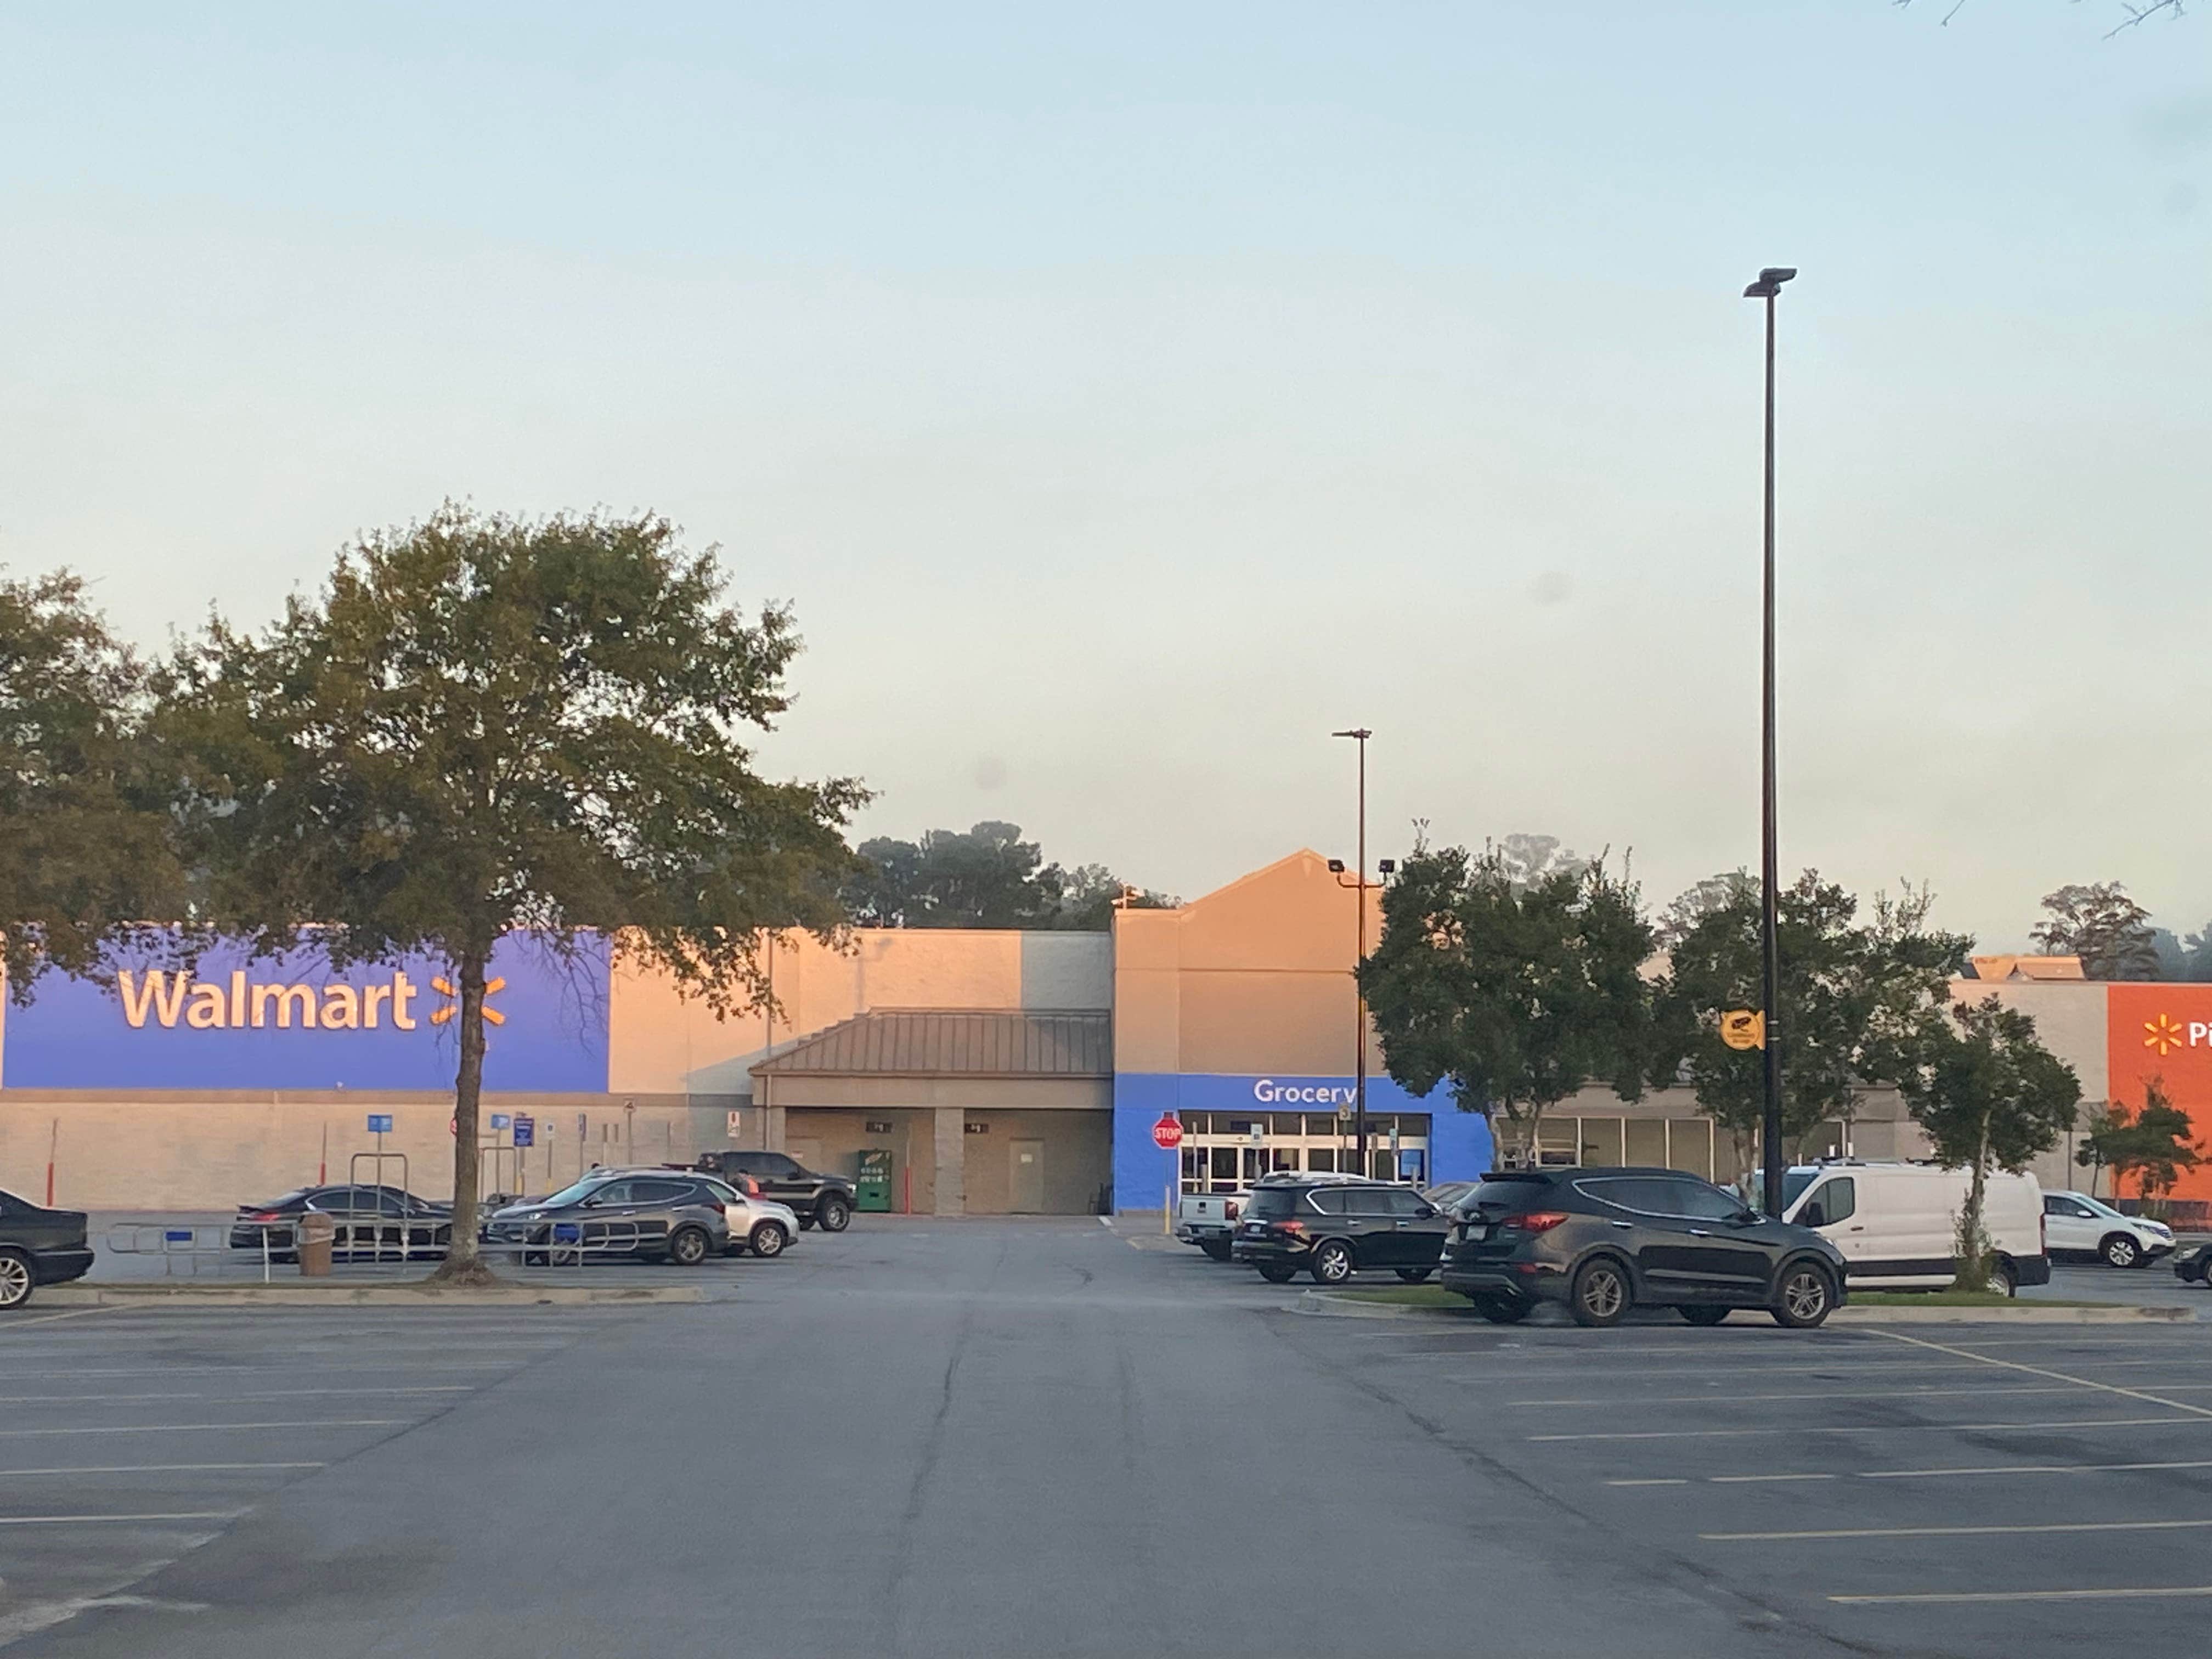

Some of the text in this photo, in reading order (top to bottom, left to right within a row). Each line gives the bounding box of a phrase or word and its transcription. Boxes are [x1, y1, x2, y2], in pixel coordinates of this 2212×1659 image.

[118, 969, 418, 1030] Walmart
[1254, 1079, 1357, 1103] Grocery
[1155, 1126, 1181, 1139] STOP
